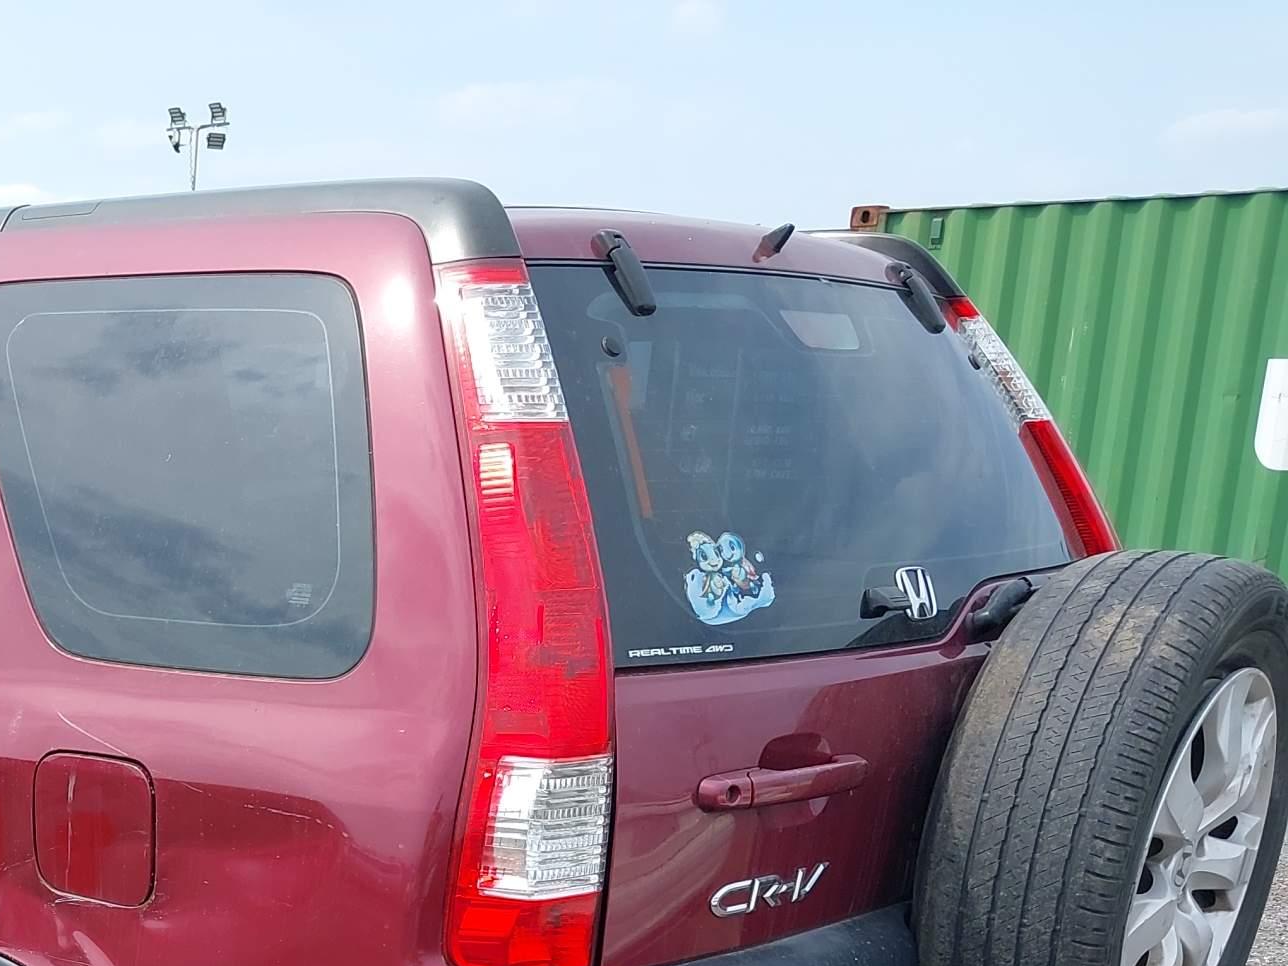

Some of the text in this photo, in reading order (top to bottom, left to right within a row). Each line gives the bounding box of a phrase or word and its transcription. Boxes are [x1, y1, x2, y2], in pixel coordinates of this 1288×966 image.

[628, 644, 734, 658] REALTIME 4WD
[708, 861, 830, 918] CR-V
